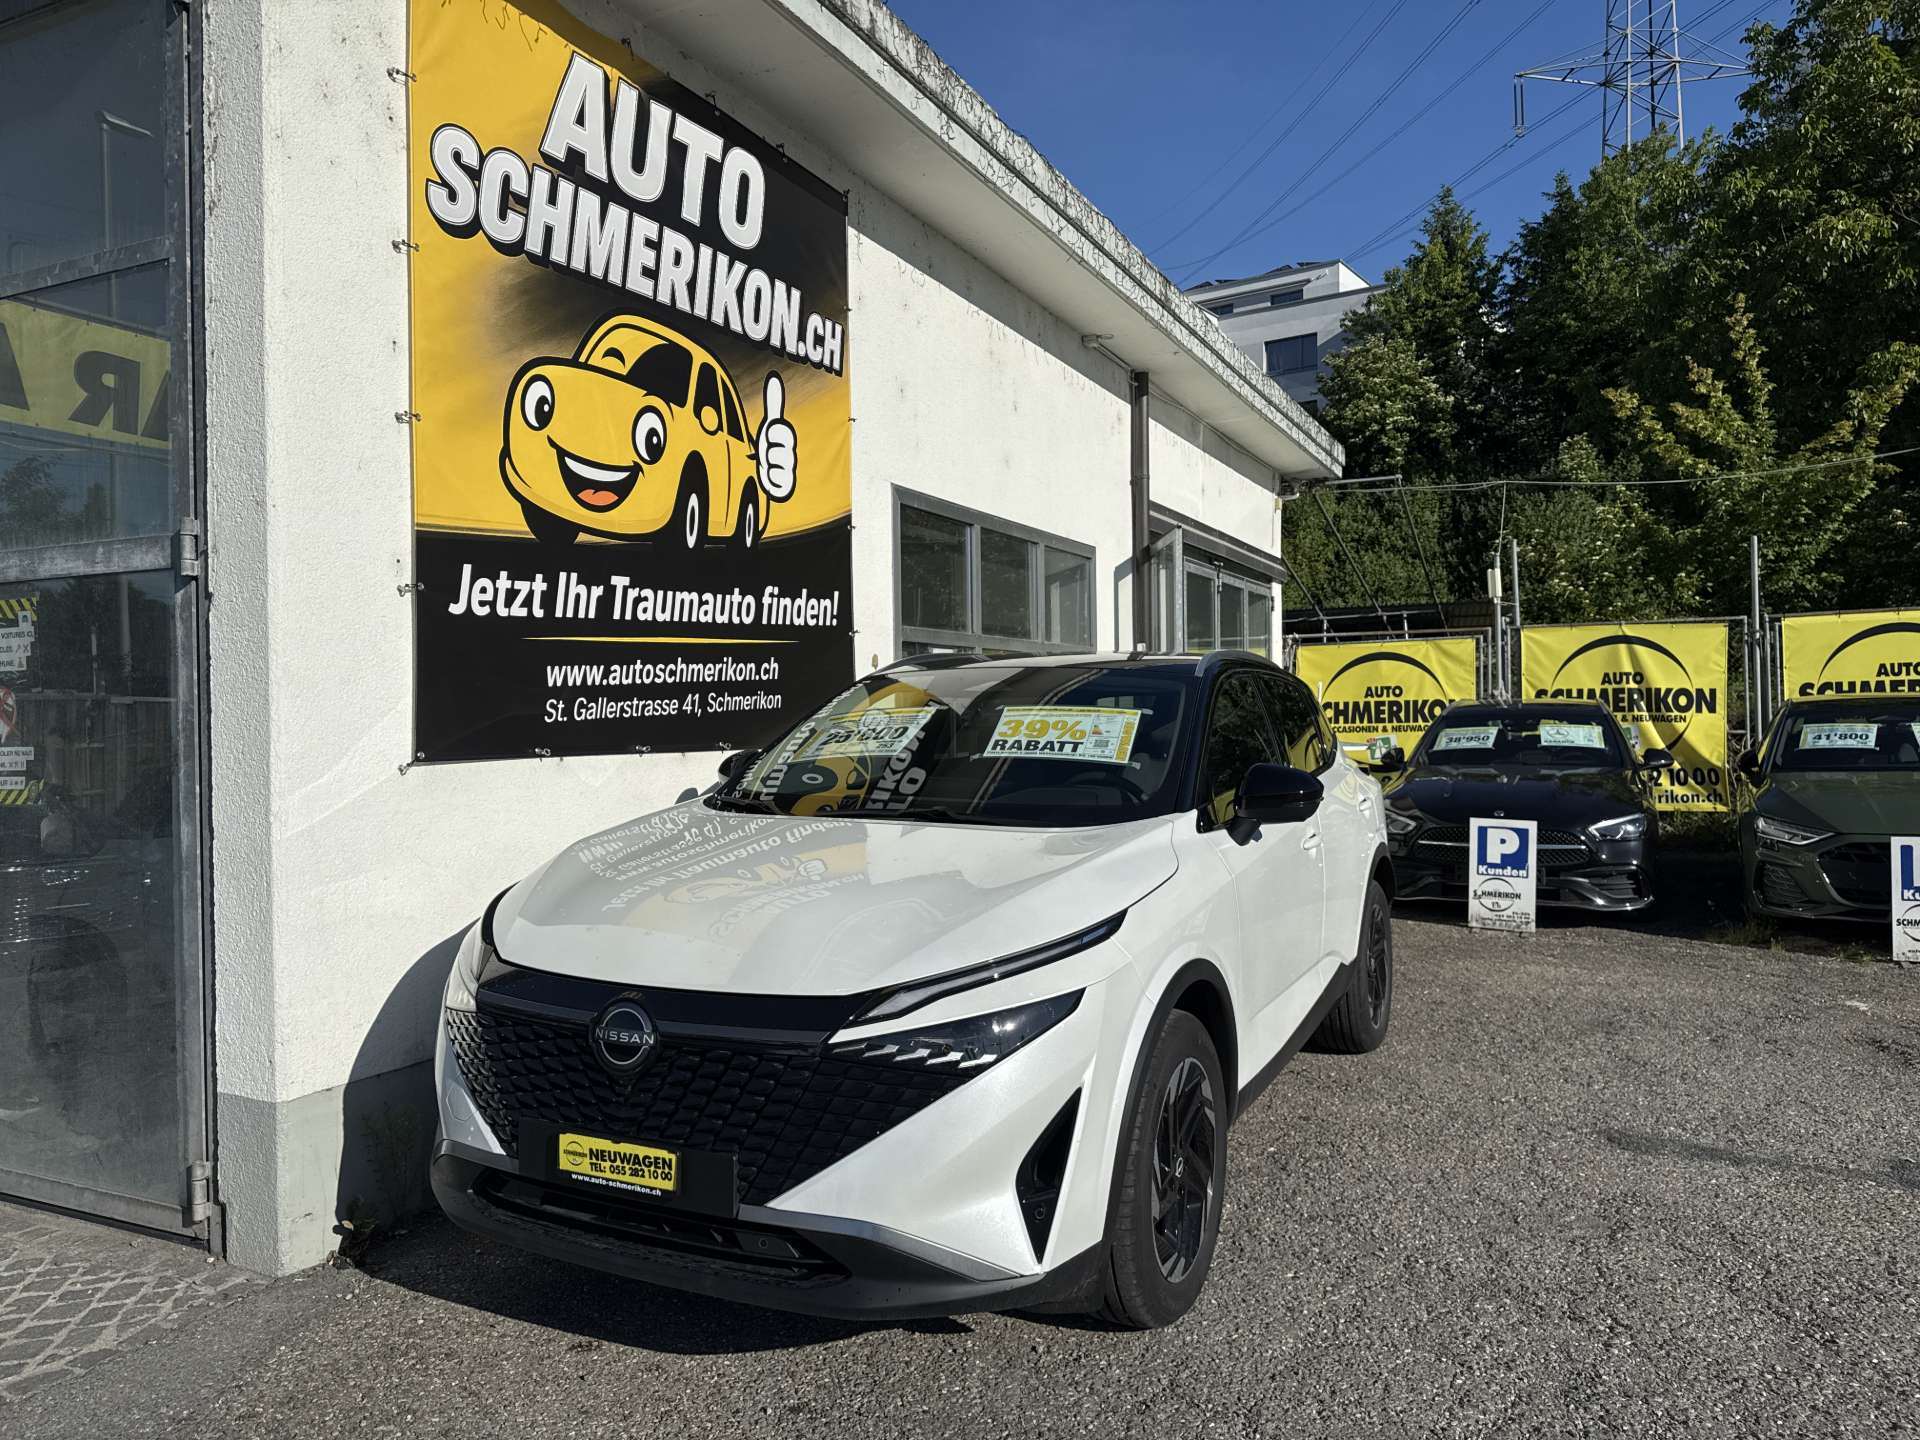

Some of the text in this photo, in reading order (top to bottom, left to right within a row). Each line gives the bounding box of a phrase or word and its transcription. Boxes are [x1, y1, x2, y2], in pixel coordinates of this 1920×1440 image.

[540, 51, 766, 250] AUTO
[427, 125, 844, 374] SCHMERIKON.CH
[448, 563, 840, 627] Jetzt Ihr Traumauto finden!
[546, 656, 779, 688] www.autoschmerikon.ch
[1600, 672, 1645, 685] AUTO
[1364, 685, 1404, 698] AUTO
[544, 691, 782, 723] St. Gallerstrasse 41, Schmerikon
[1321, 699, 1456, 725] CHMERIKO
[1631, 714, 1687, 723] NEUWAGEN
[998, 719, 1087, 740] 39%
[1332, 725, 1379, 733] CCASIONEN
[1381, 725, 1388, 733] &
[1812, 733, 1869, 741] 41'800
[991, 739, 1084, 753] RABATT
[1669, 768, 1688, 786] 10
[1692, 767, 1721, 787] 00
[1654, 790, 1723, 804] rikon.ch
[1486, 828, 1520, 864] P
[1478, 865, 1527, 877] Kunden
[1473, 889, 1521, 900] SHMERIKON
[595, 1028, 654, 1044] NISSAN
[588, 1147, 673, 1171] NEUWAGEN
[589, 1162, 673, 1181] TEL: 055 282 10 00
[571, 1173, 661, 1196] www.auto-schmerikon.ch
